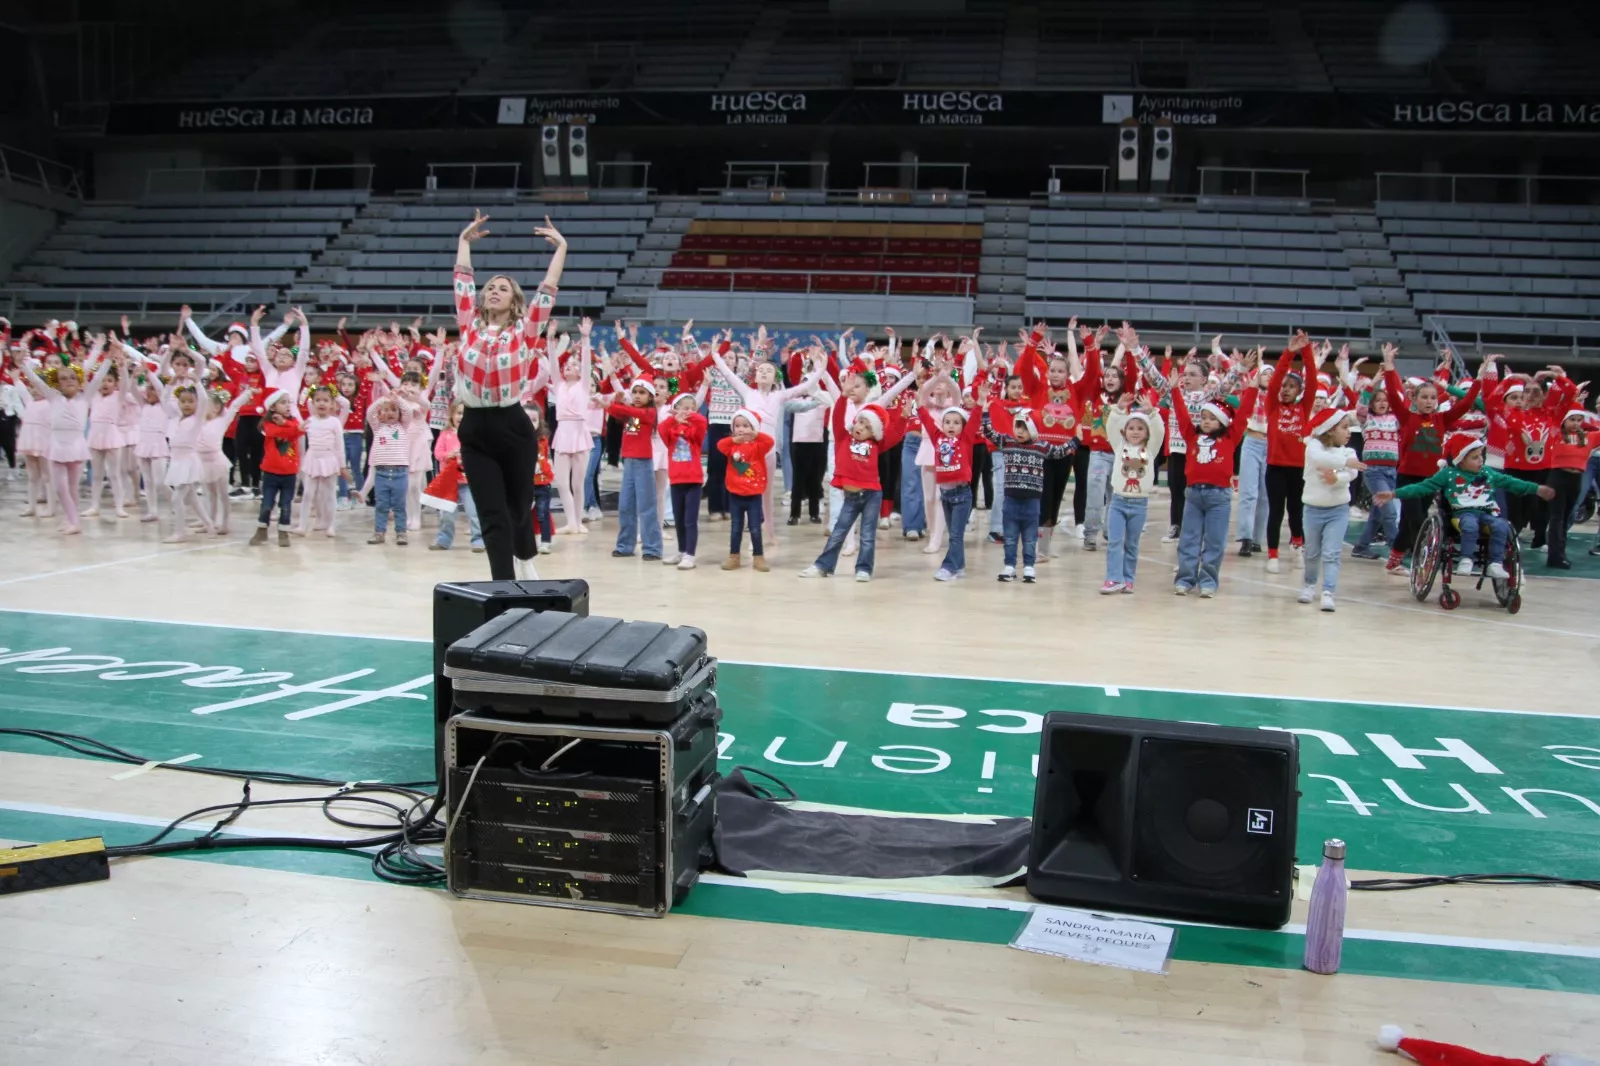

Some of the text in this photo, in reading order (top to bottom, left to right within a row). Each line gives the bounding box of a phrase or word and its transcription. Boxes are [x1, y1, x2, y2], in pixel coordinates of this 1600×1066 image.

[530, 98, 620, 112] Ayuntamiento
[1138, 95, 1243, 111] Ayuntamiento
[1138, 111, 1156, 125] de
[1042, 928, 1092, 941] JUEVES
